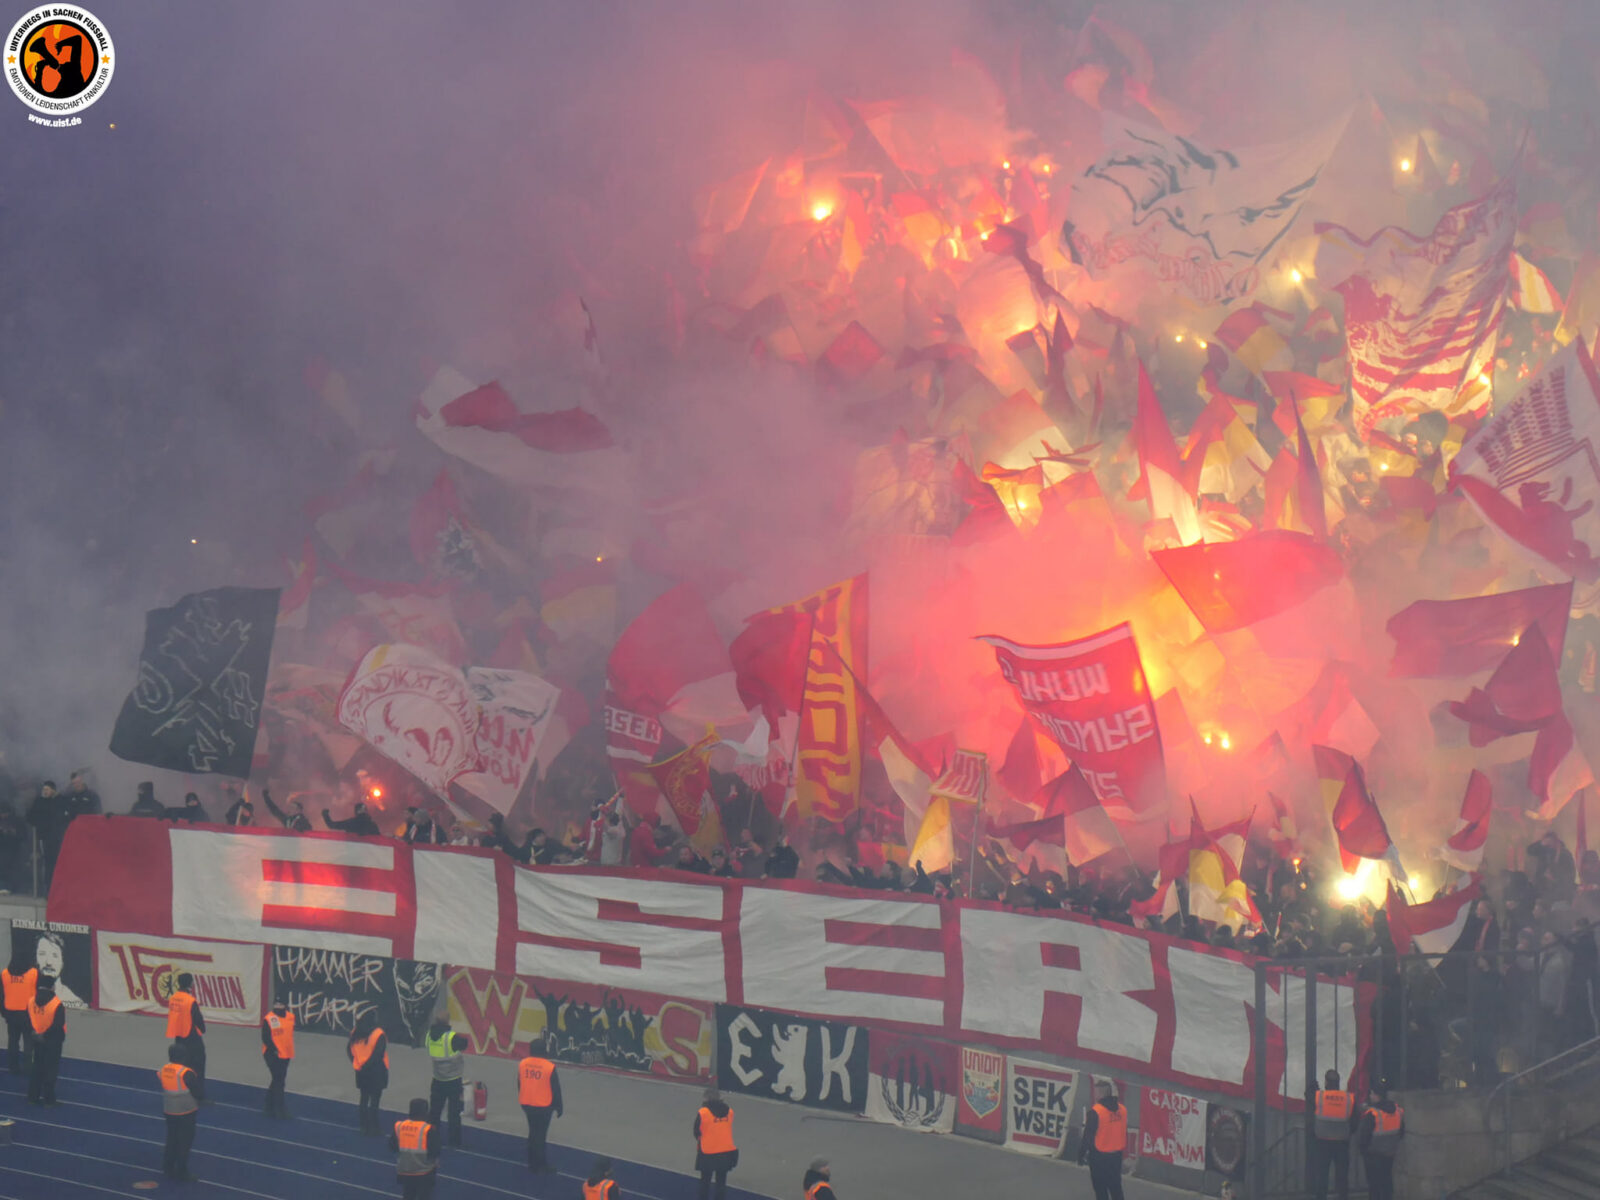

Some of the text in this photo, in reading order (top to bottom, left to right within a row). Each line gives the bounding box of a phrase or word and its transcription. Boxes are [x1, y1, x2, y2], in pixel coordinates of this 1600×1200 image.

[12, 919, 47, 931] EINMAL
[168, 827, 1358, 1100] EISERN
[275, 946, 383, 993] HAMMER
[448, 967, 706, 1076] W S
[526, 1069, 541, 1080] 190
[963, 1049, 1001, 1076] UNION
[1013, 1077, 1071, 1113] SEK
[1149, 1089, 1200, 1115] GARDE
[1143, 1132, 1205, 1162] BARNIM
